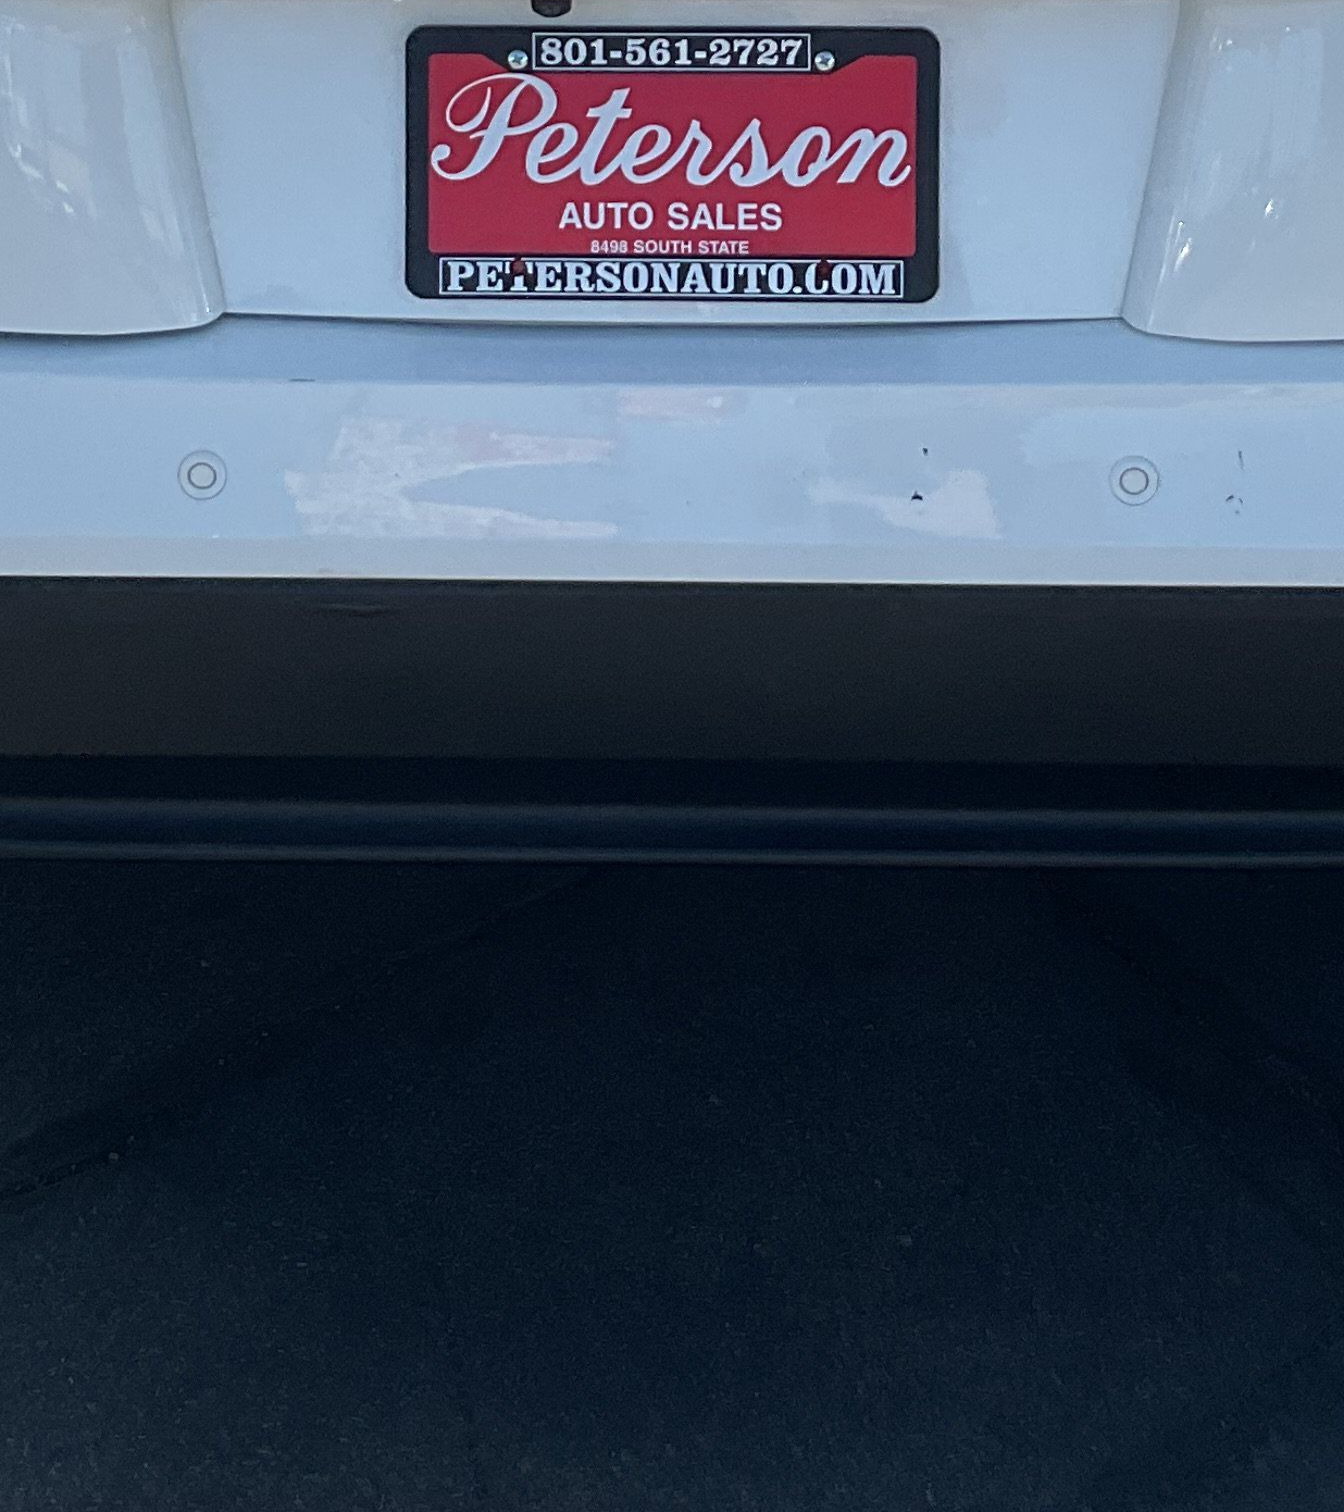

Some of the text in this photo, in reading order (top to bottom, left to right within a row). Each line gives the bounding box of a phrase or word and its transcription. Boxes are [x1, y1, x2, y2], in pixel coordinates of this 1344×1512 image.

[539, 37, 804, 67] 801-561-2727
[430, 72, 912, 188] Peterson
[558, 201, 783, 232] AUTO SALES
[590, 239, 750, 255] 8498 SOUTH STATE
[446, 260, 896, 295] PETERSONAUTO.COM
